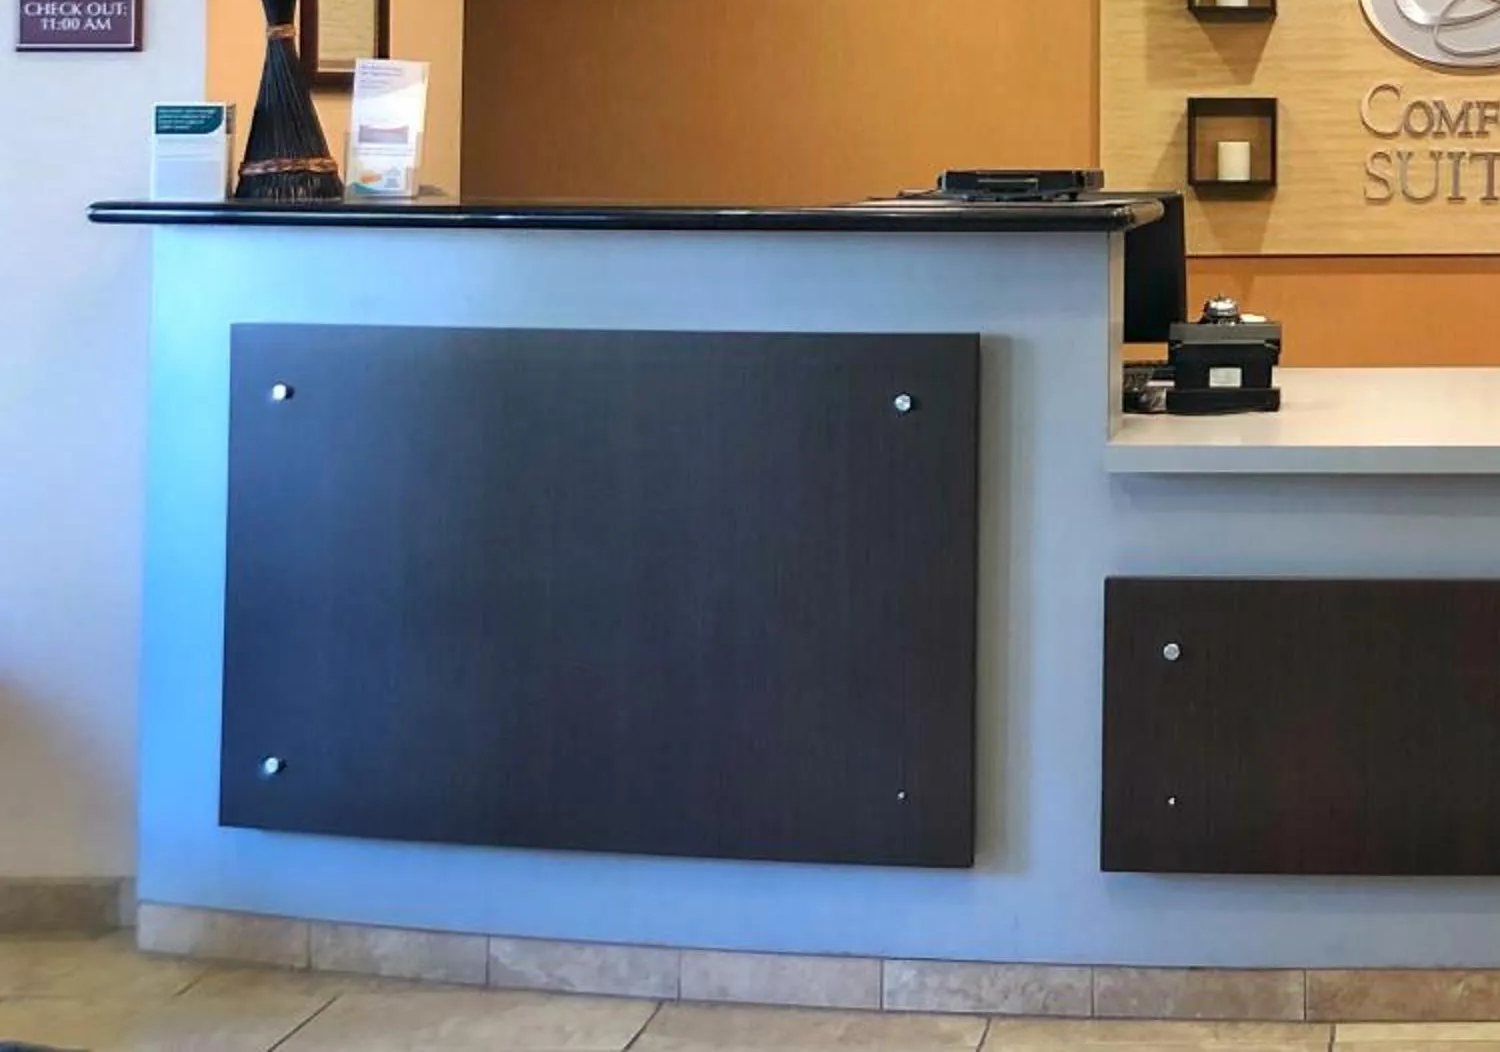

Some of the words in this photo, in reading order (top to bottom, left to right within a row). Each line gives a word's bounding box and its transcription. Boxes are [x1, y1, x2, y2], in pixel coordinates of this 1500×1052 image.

[24, 1, 82, 16] CHECK
[87, 1, 128, 16] OUT:
[41, 18, 80, 30] 11:00
[84, 18, 111, 30] AM
